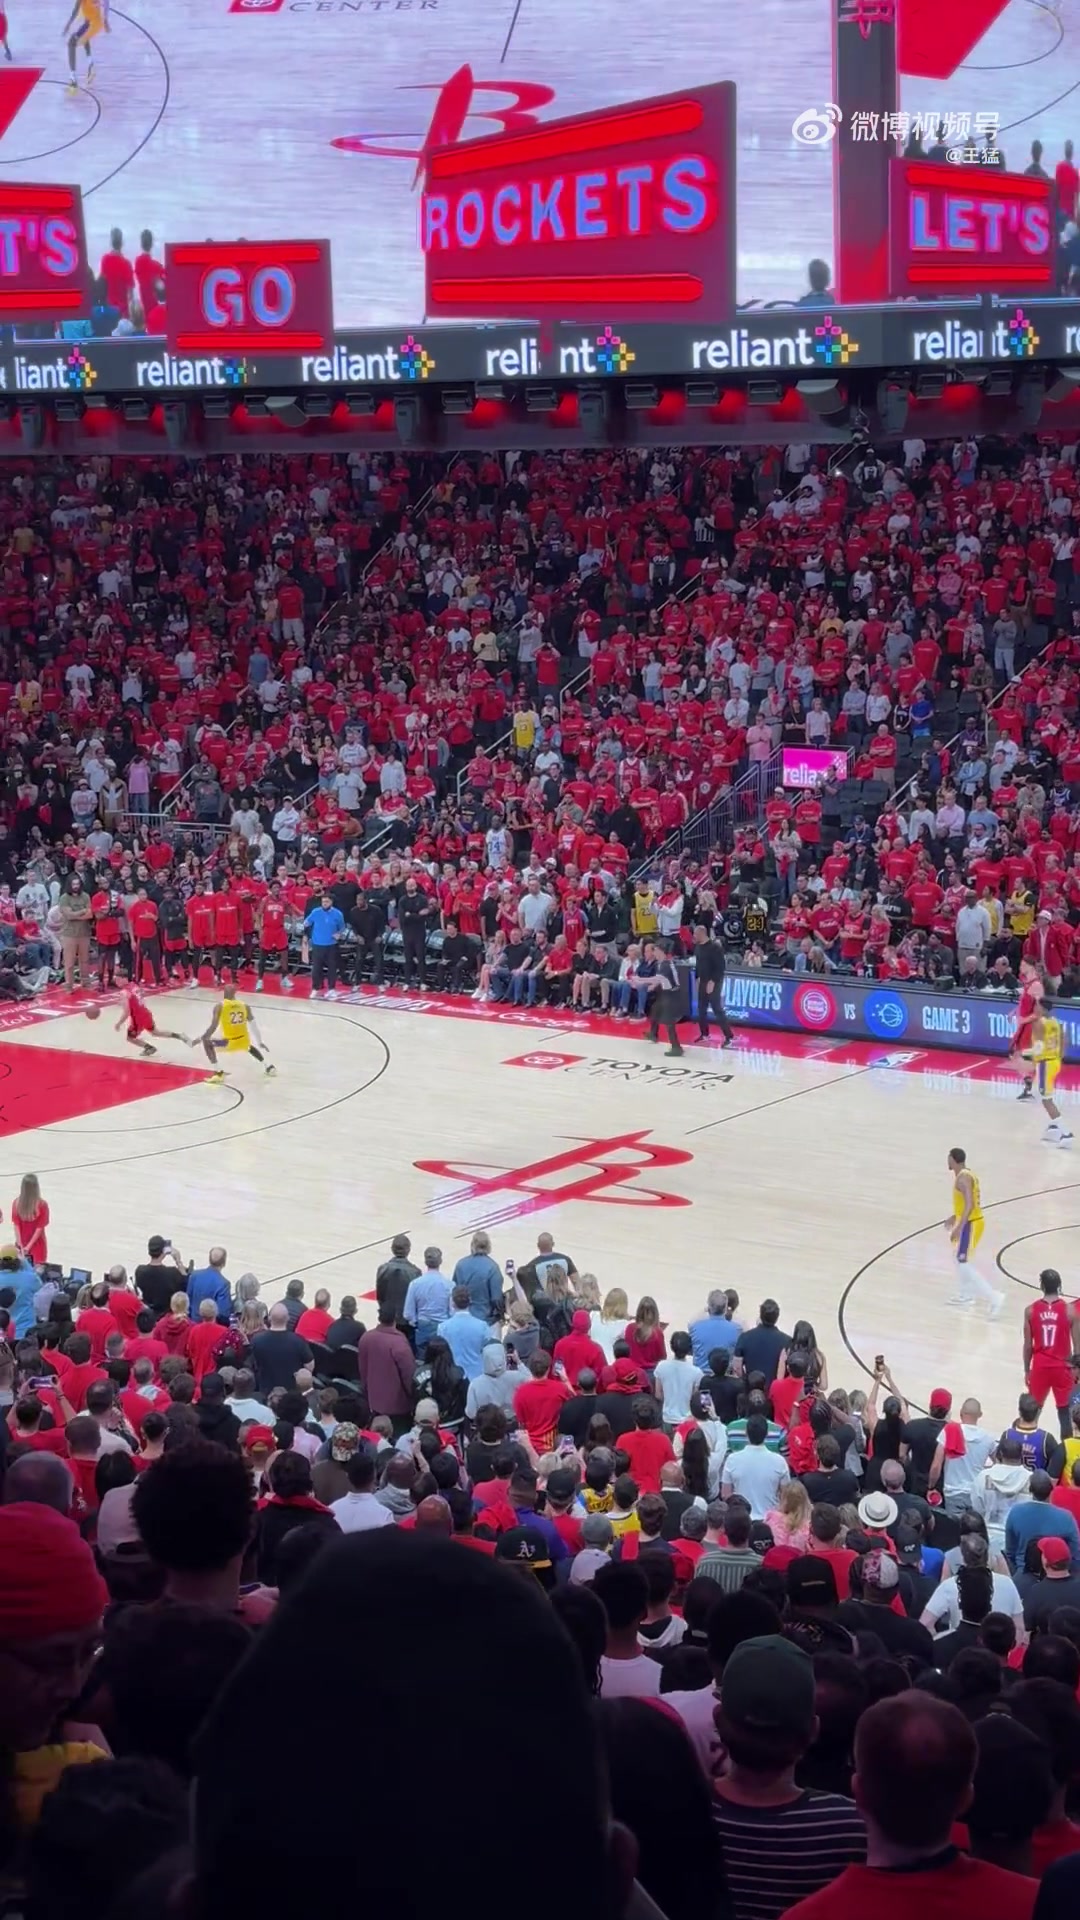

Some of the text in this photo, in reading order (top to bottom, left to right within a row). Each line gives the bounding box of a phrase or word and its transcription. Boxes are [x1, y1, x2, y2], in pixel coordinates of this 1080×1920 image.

[423, 157, 708, 250] ROCKETS
[910, 193, 1050, 255] LET'S
[201, 265, 295, 326] GO
[486, 337, 598, 377] relint
[691, 326, 816, 369] reliant
[136, 352, 228, 388] reliant
[301, 345, 402, 383] reliant
[230, 1010, 245, 1025] 23
[498, 1011, 592, 1029] Google
[843, 1003, 856, 1020] VS
[922, 1005, 971, 1034] GAME 3
[564, 1066, 718, 1091] CENTER
[589, 1057, 735, 1083] TOYOTA
[1041, 1324, 1058, 1348] 17
